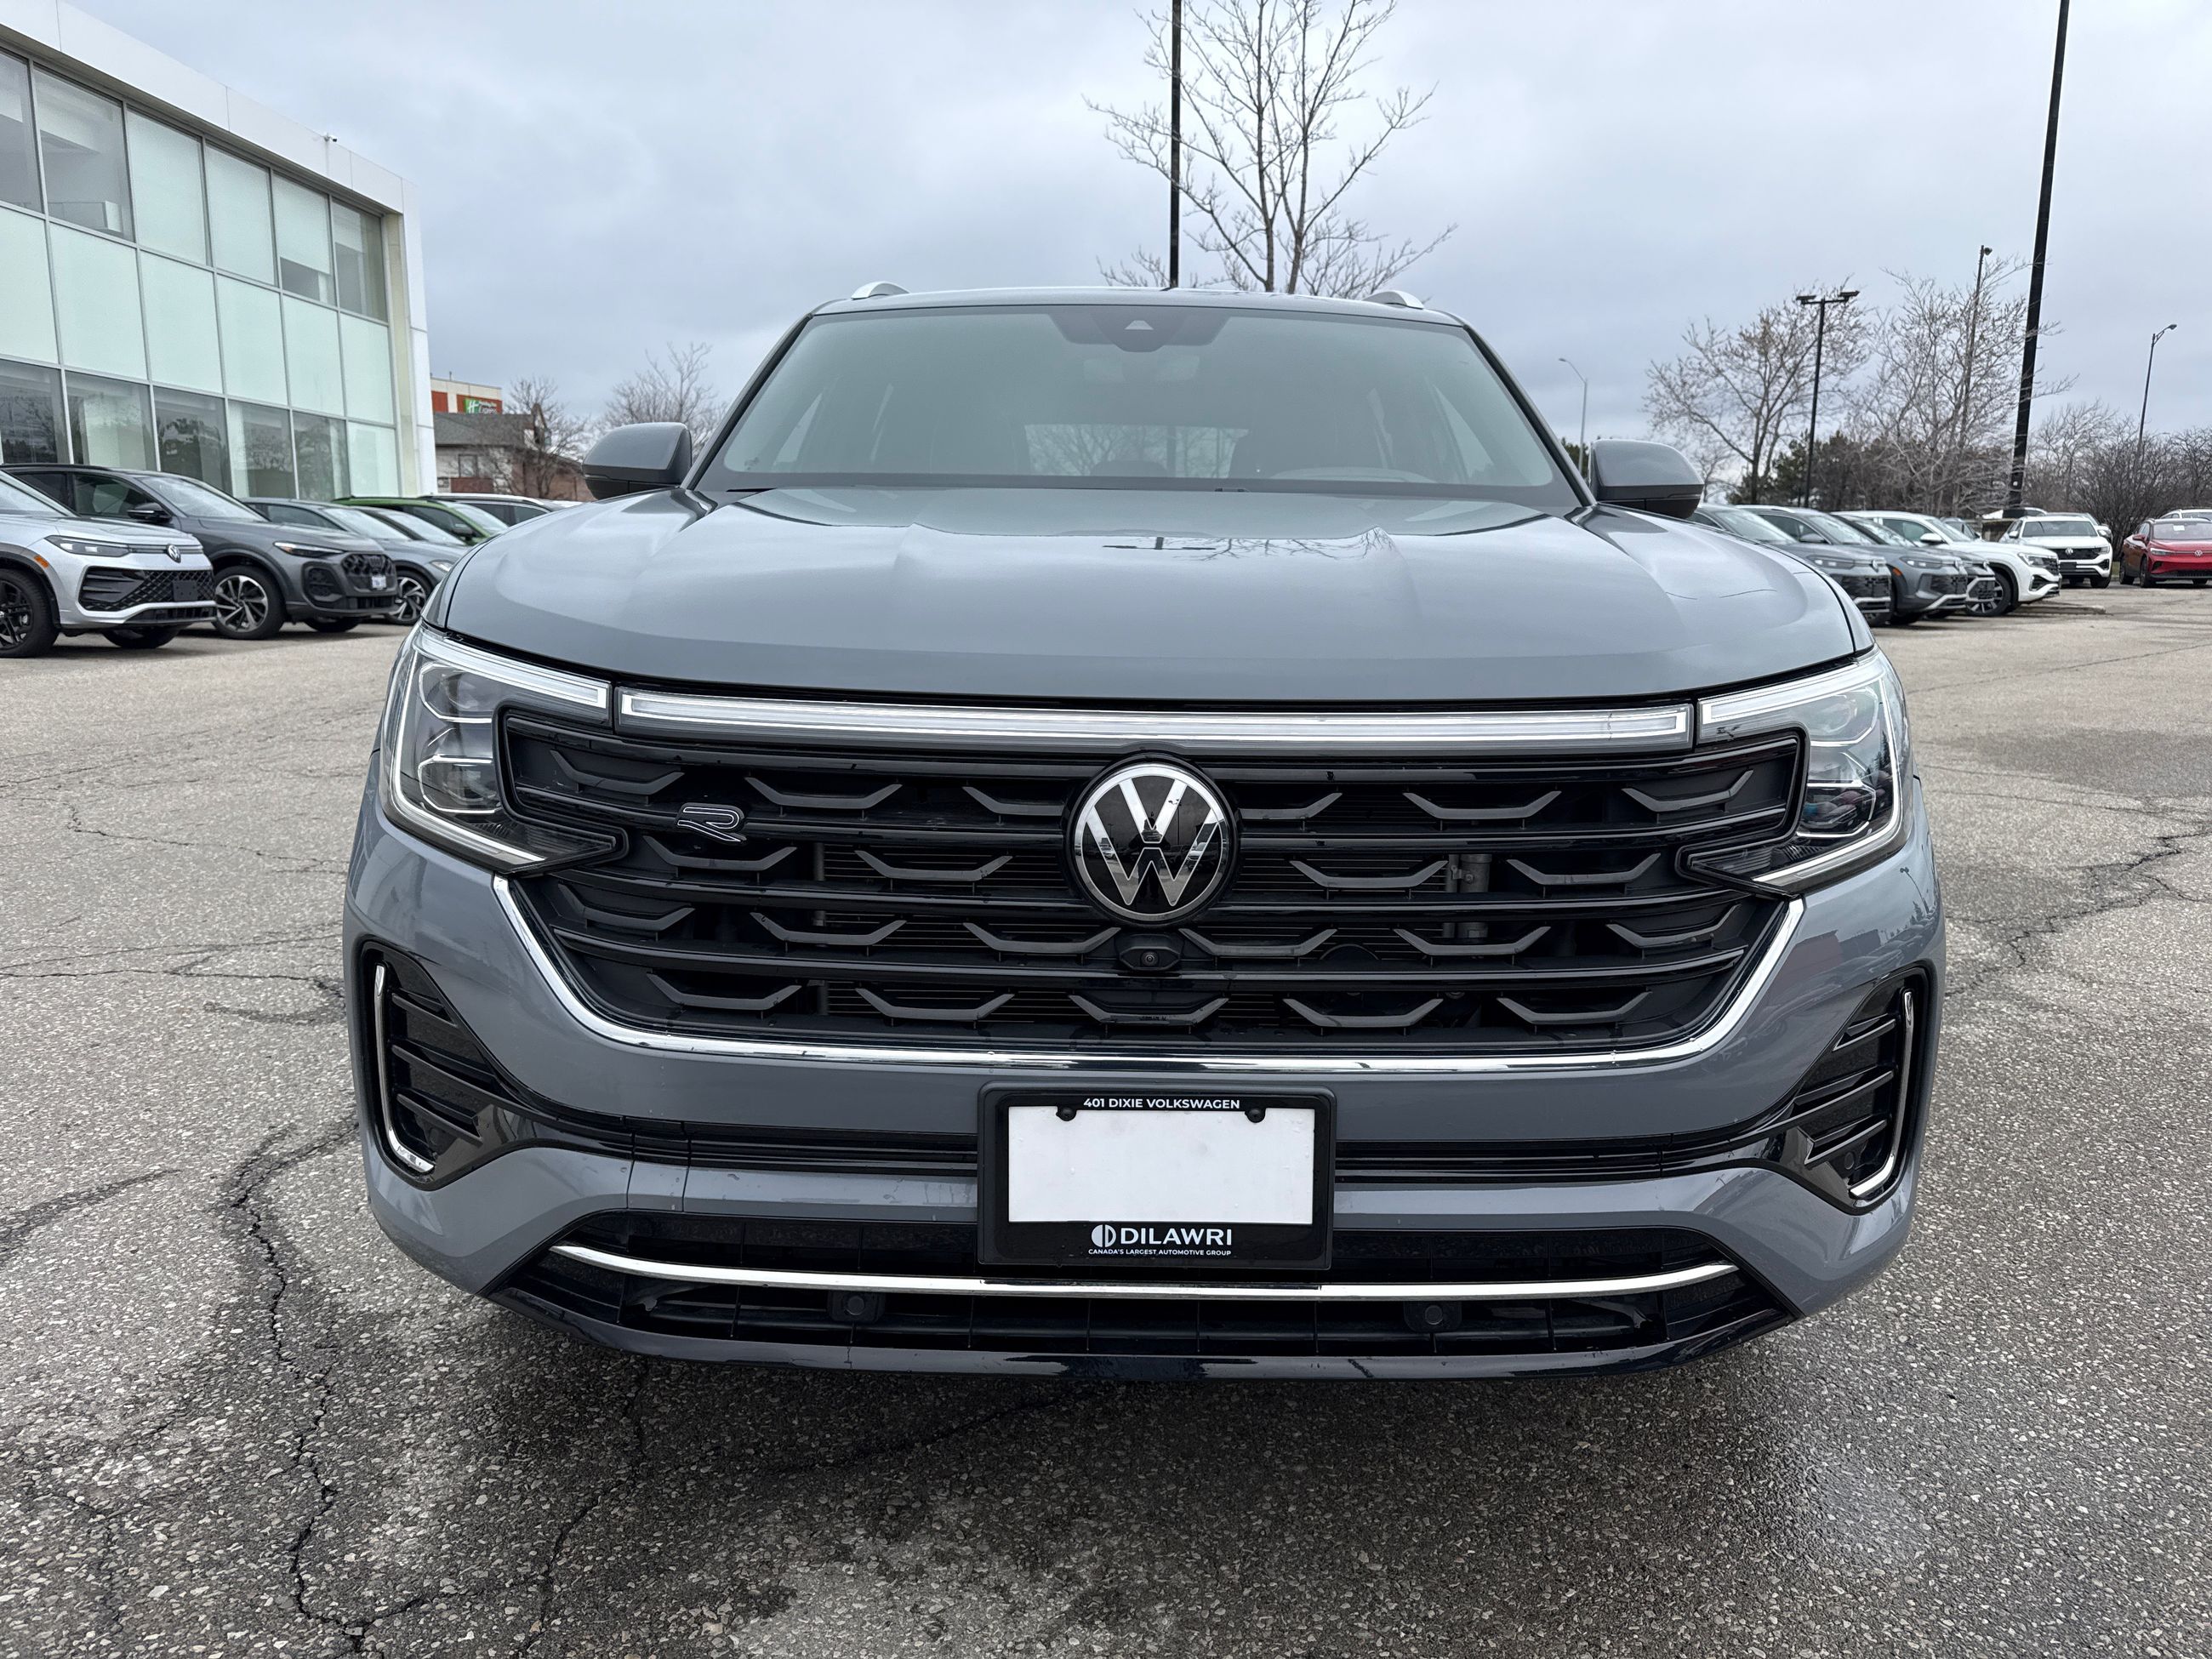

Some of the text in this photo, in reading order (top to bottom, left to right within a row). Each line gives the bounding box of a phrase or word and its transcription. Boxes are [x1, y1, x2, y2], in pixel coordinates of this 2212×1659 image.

[1081, 776, 1223, 907] VW
[1083, 1097, 1240, 1109] 401 DIXIE VOLKSWAGEN
[1120, 1227, 1232, 1246] DILAWRI
